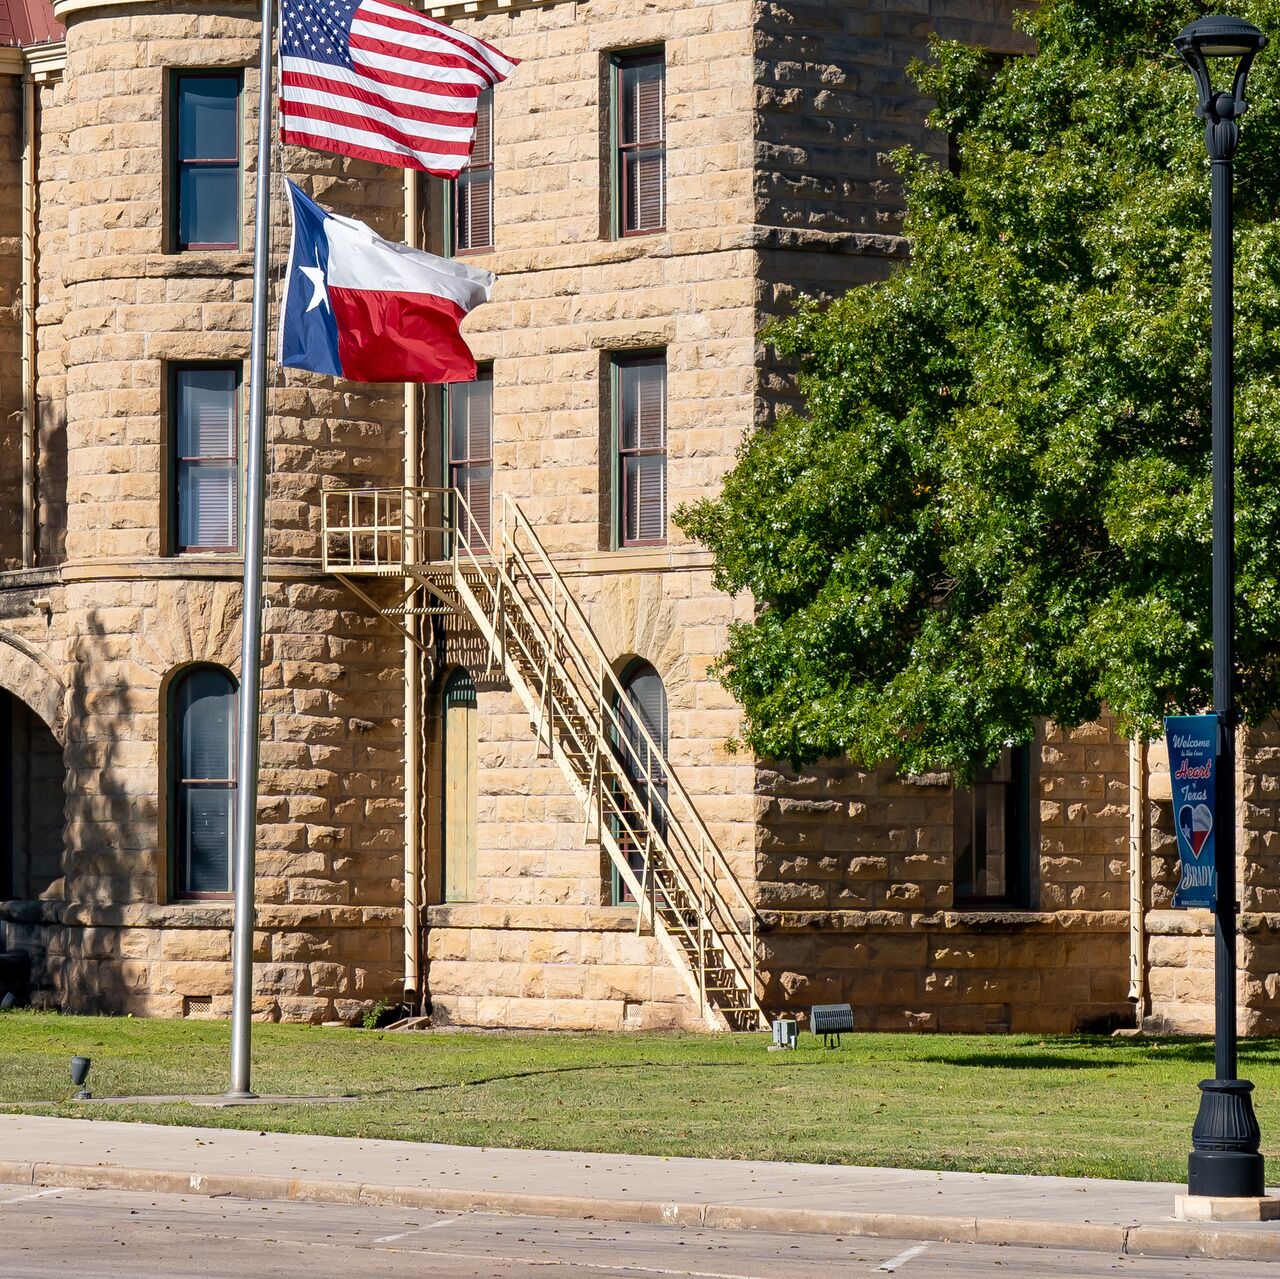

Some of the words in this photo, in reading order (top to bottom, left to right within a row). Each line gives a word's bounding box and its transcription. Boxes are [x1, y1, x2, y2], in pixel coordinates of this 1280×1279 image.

[1173, 734, 1211, 748] Welcome
[1175, 758, 1212, 780] Heart
[1181, 785, 1207, 801] Texas
[1181, 863, 1215, 890] BRADY
